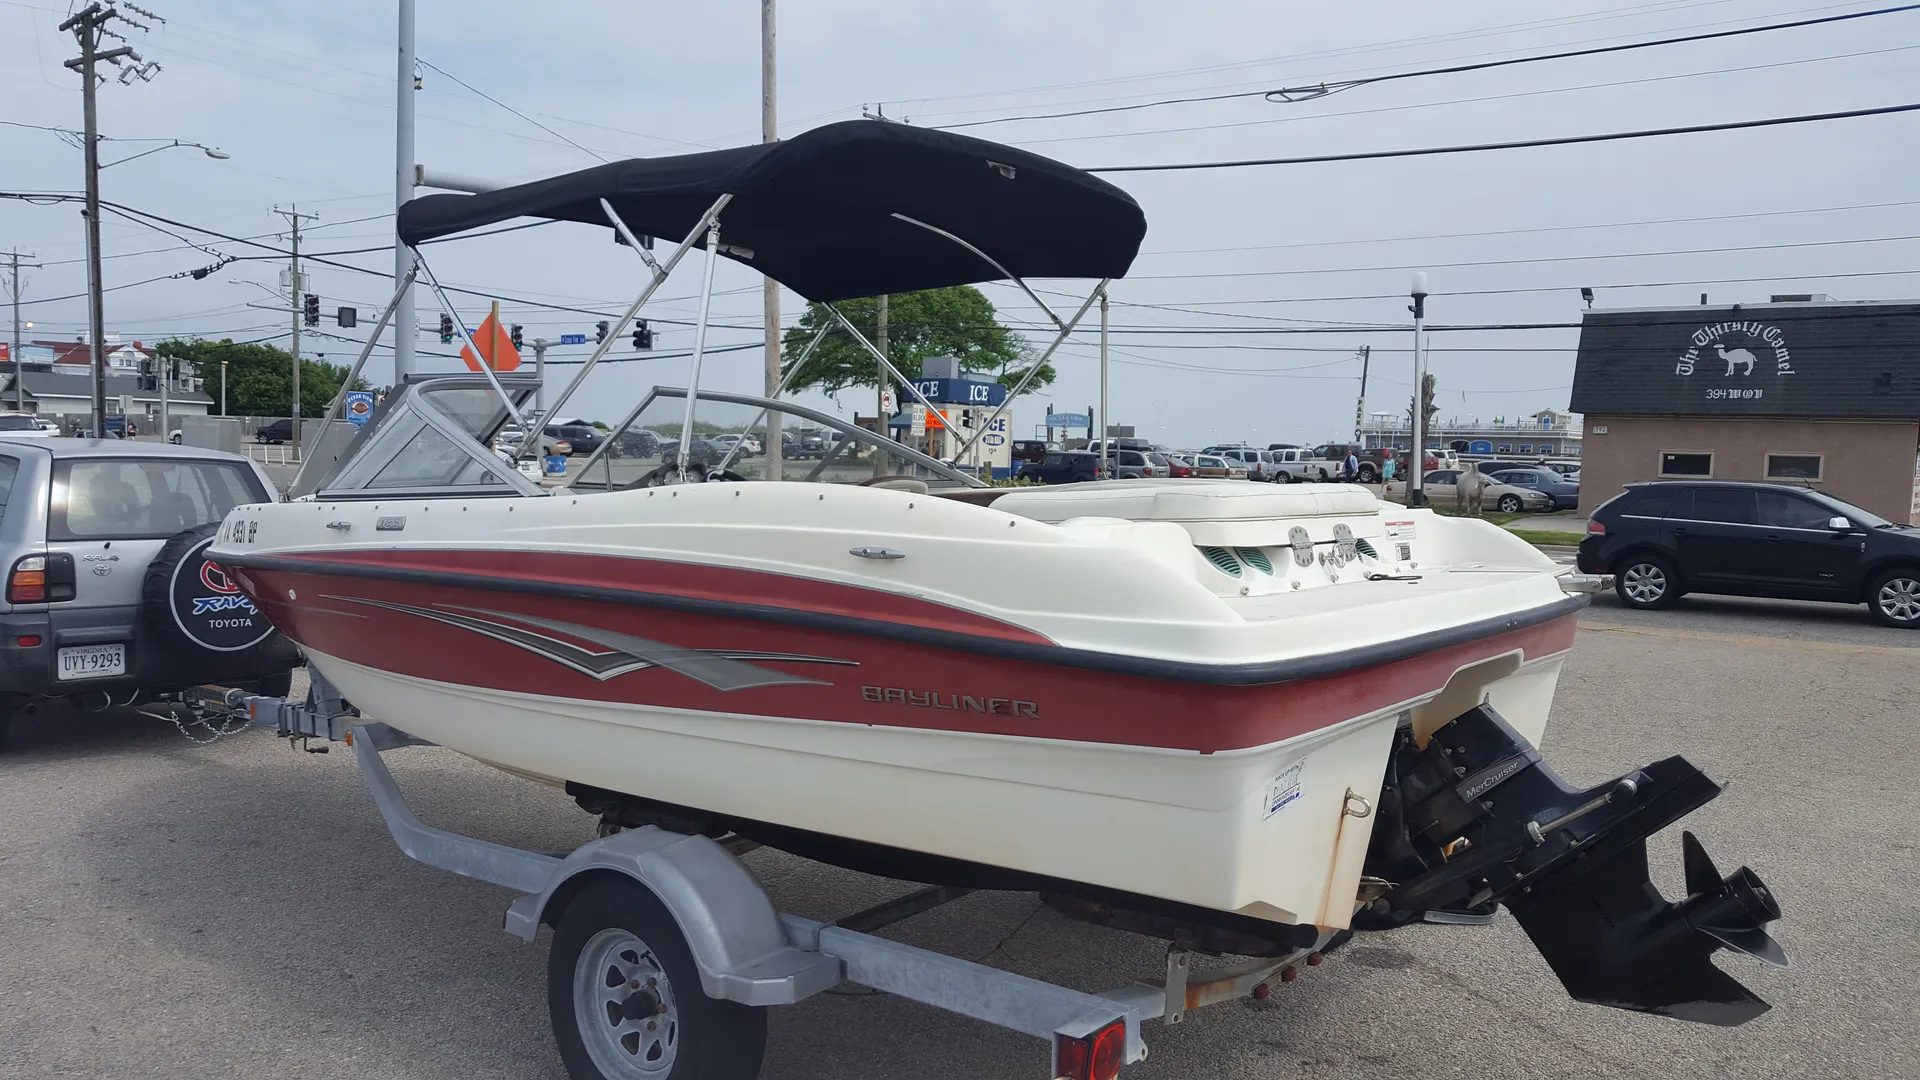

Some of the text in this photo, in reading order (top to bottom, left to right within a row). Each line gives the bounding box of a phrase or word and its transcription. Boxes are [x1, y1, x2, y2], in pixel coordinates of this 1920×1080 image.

[1676, 321, 1796, 376] The Thirsty Camel
[913, 381, 939, 398] ICE
[969, 385, 989, 401] ICE
[208, 618, 252, 629] TOYOTA
[76, 647, 108, 655] VIRGINIA
[64, 652, 121, 671] UVY-9293
[861, 685, 1040, 719] BAYLINER
[1466, 761, 1519, 799] MerCruiser
